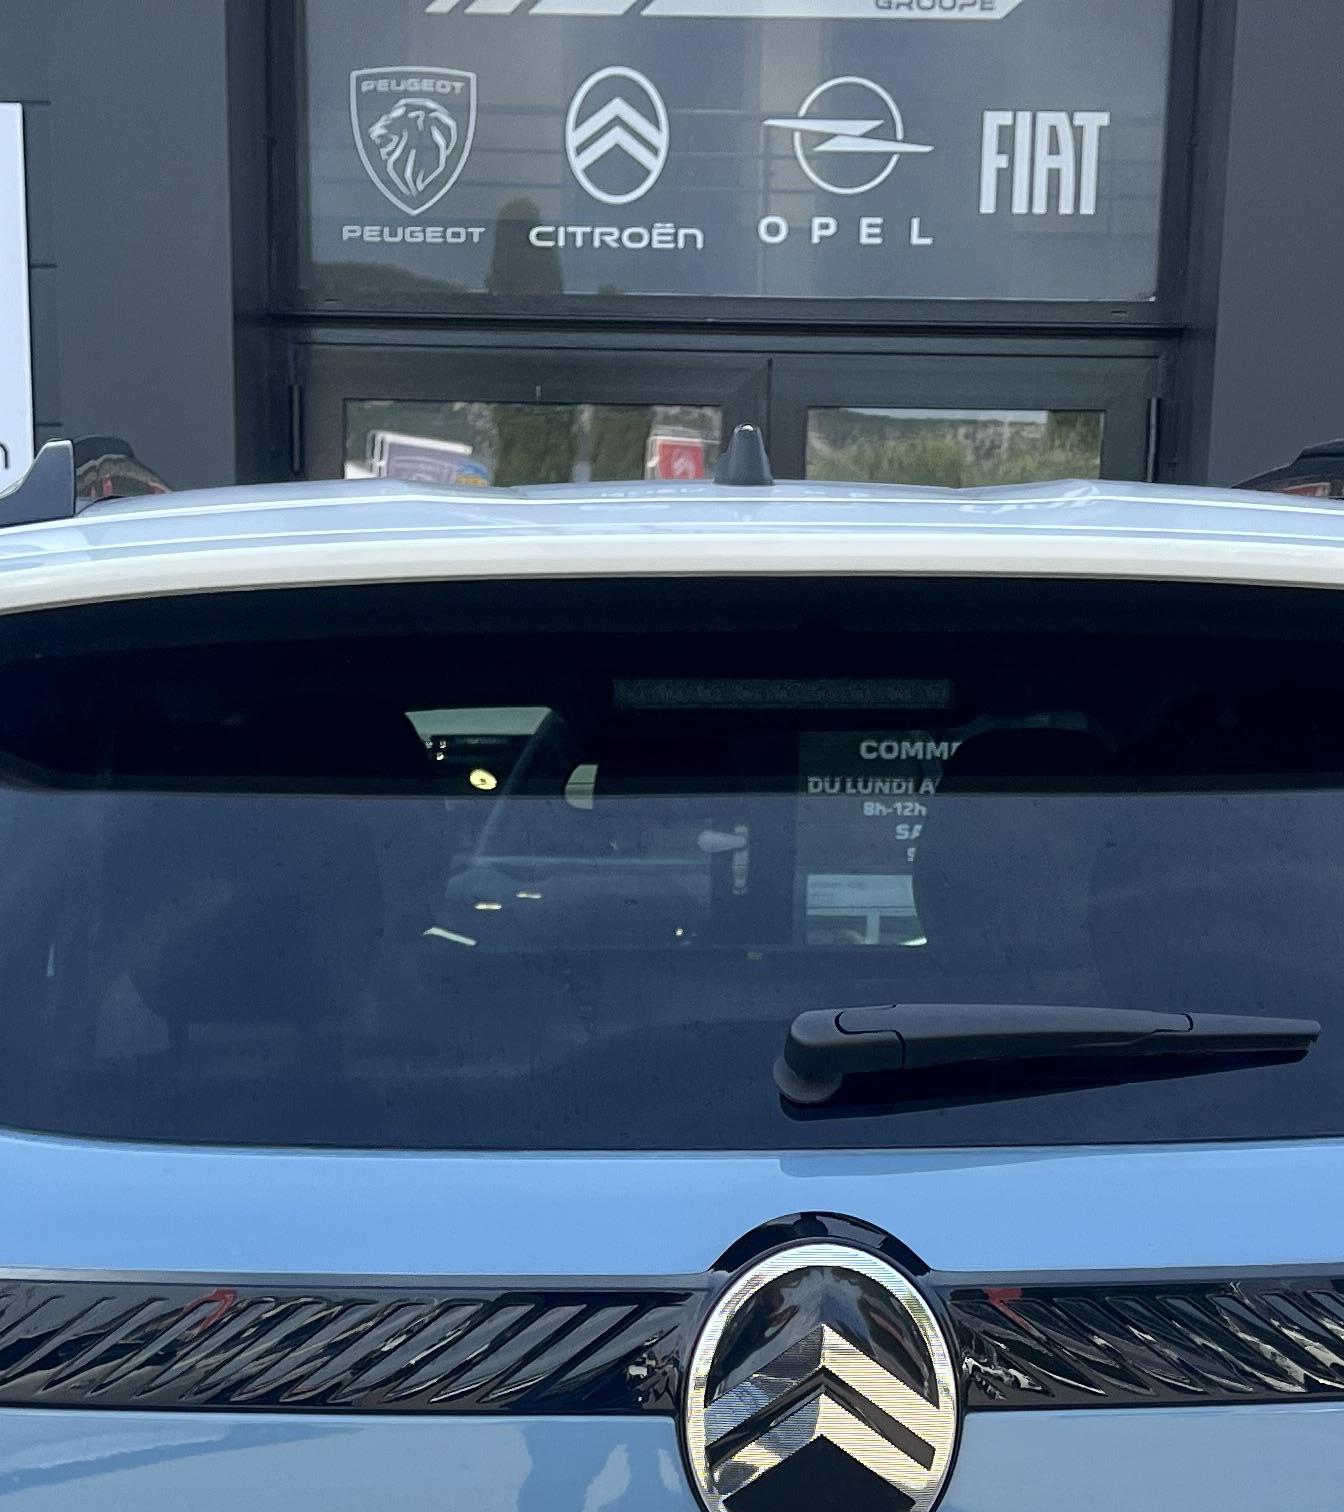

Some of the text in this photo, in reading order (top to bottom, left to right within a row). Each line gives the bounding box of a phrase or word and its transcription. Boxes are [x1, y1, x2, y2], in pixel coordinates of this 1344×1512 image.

[361, 79, 465, 95] PEUGEOT
[979, 110, 1111, 214] FIAT
[342, 225, 486, 243] PEUGEOT
[529, 222, 704, 250] CITROËN
[758, 215, 933, 245] OPEL
[807, 776, 840, 794] DU
[845, 777, 914, 795] LUNDI
